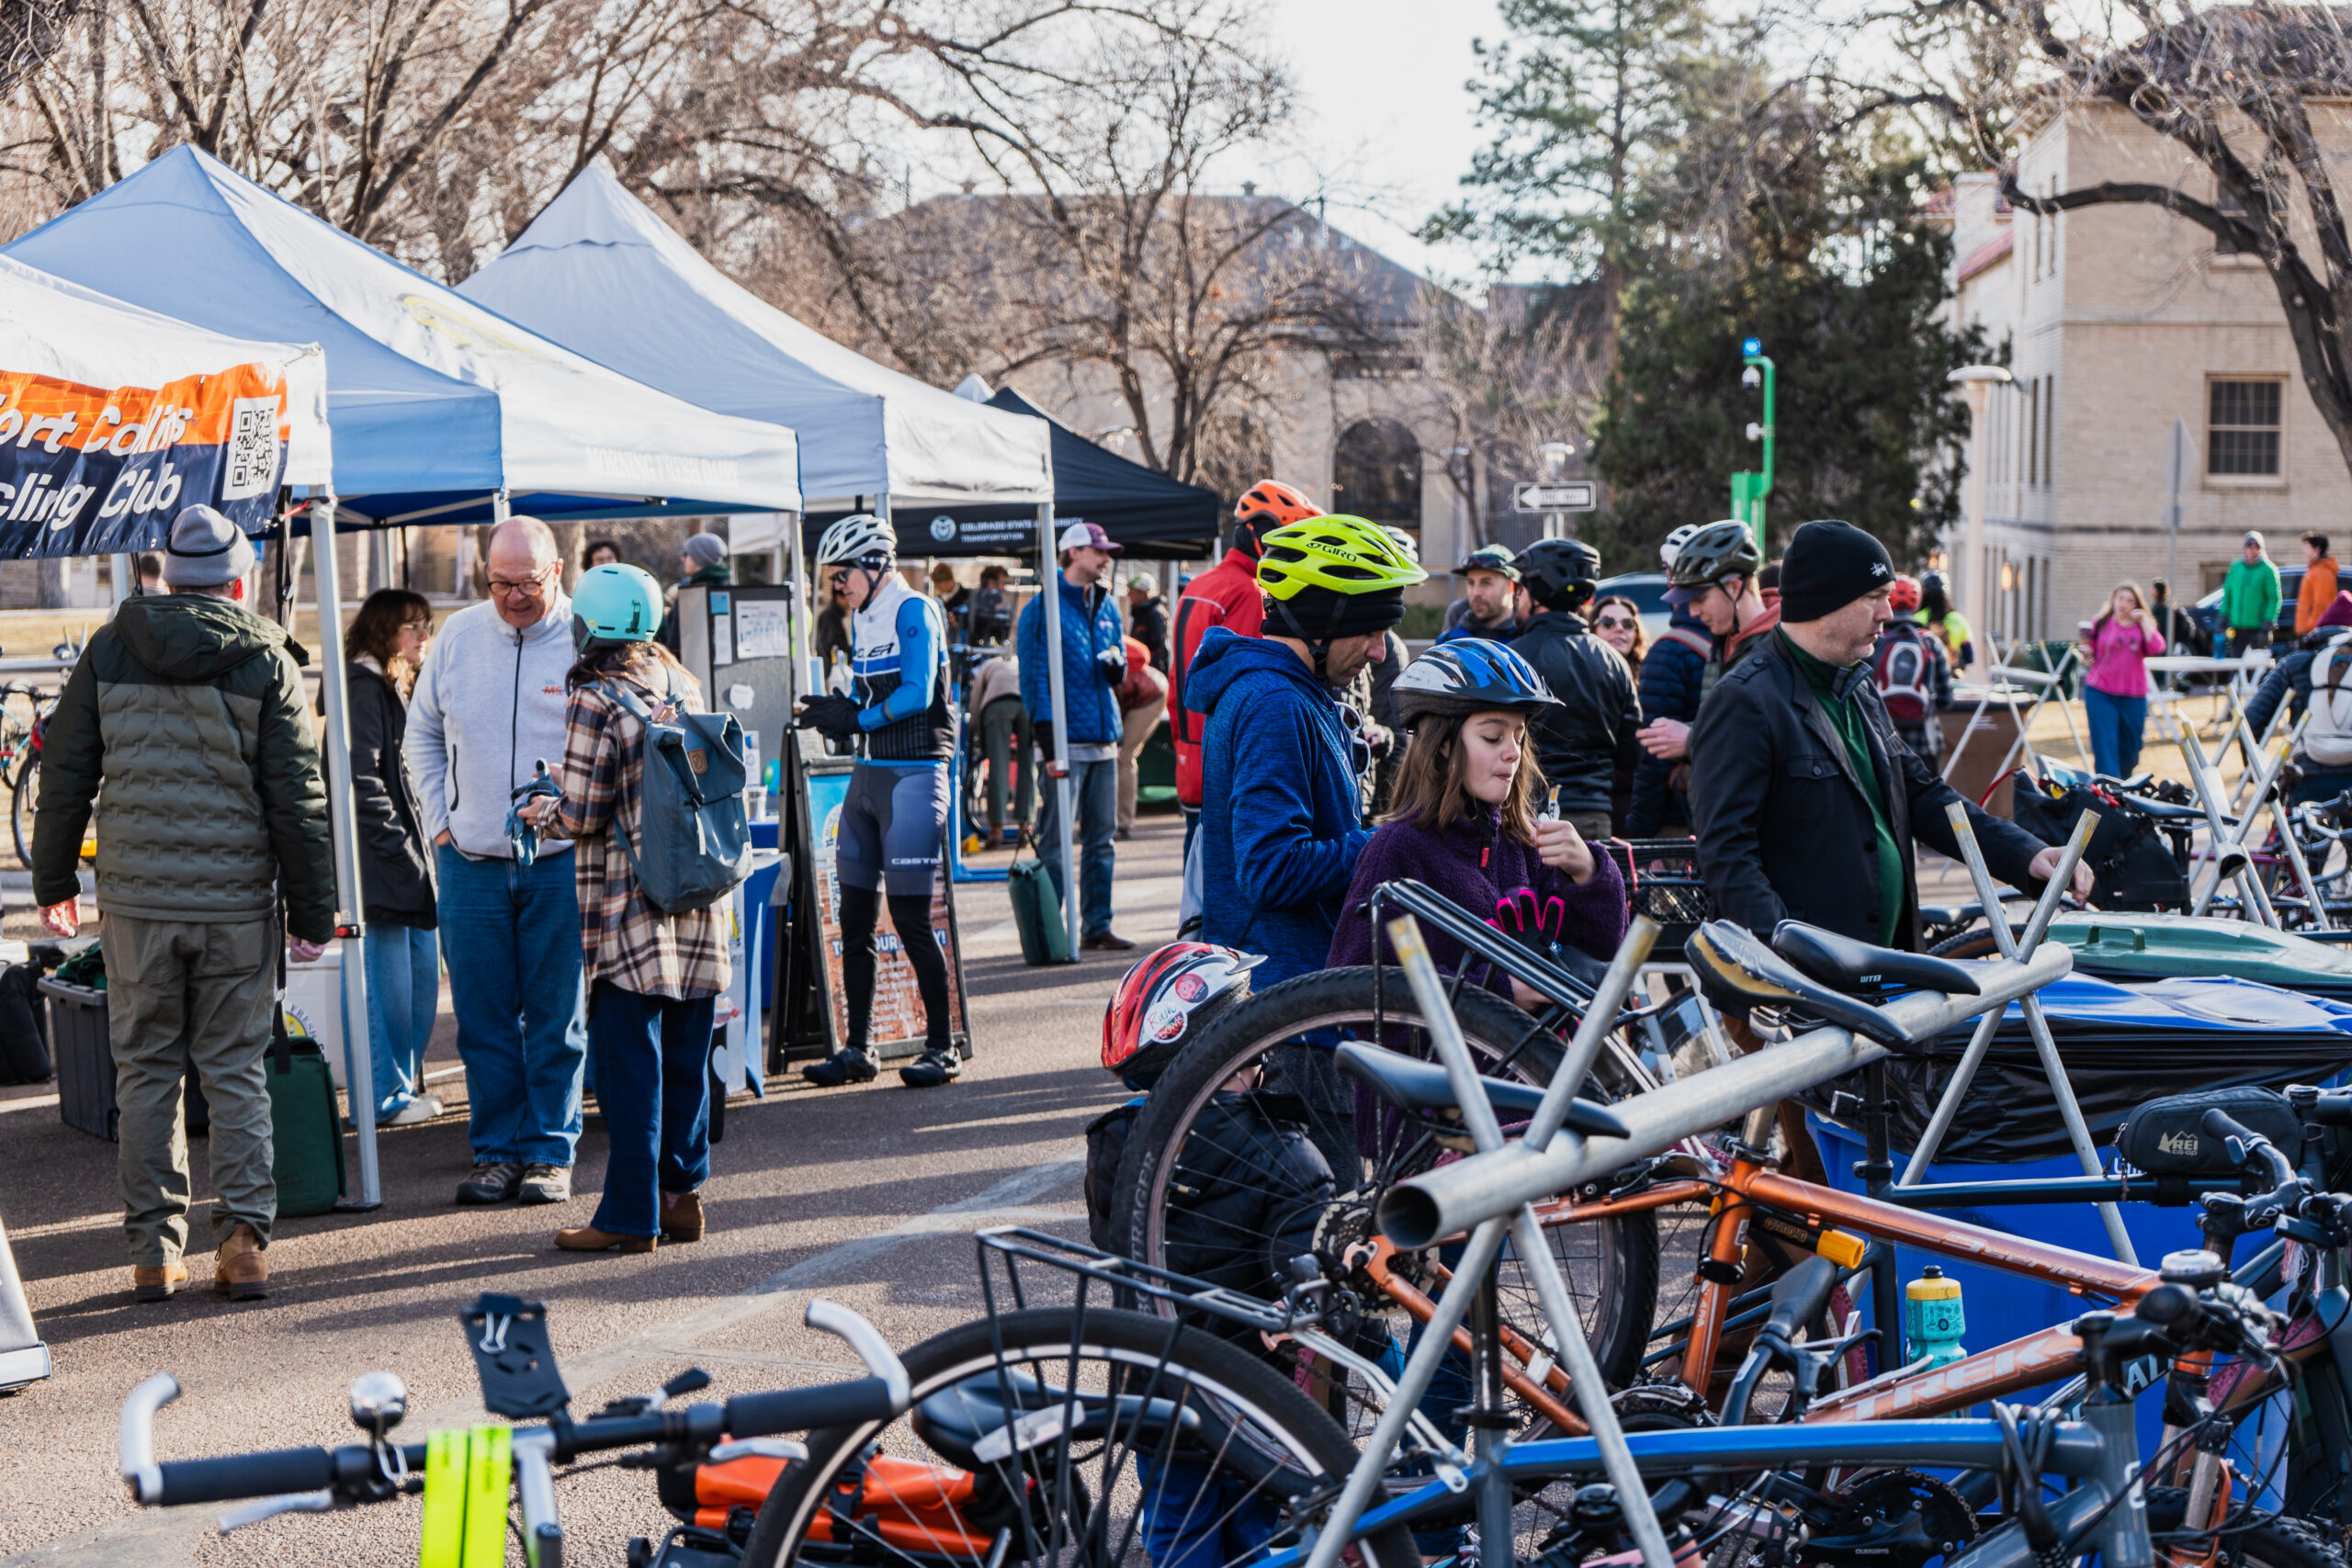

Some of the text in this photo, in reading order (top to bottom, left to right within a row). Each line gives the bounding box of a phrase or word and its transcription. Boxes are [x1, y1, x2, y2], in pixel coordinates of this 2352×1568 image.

[0, 393, 79, 454] ort
[99, 463, 182, 518] Club
[959, 521, 1006, 533] COLORADO
[1007, 519, 1033, 530] STATE
[961, 532, 1025, 544] TRANSPORTATION
[1322, 545, 1357, 562] GIRO
[1860, 975, 1882, 983] WTB
[2172, 1139, 2199, 1151] REI
[1839, 1337, 2052, 1421] TREK
